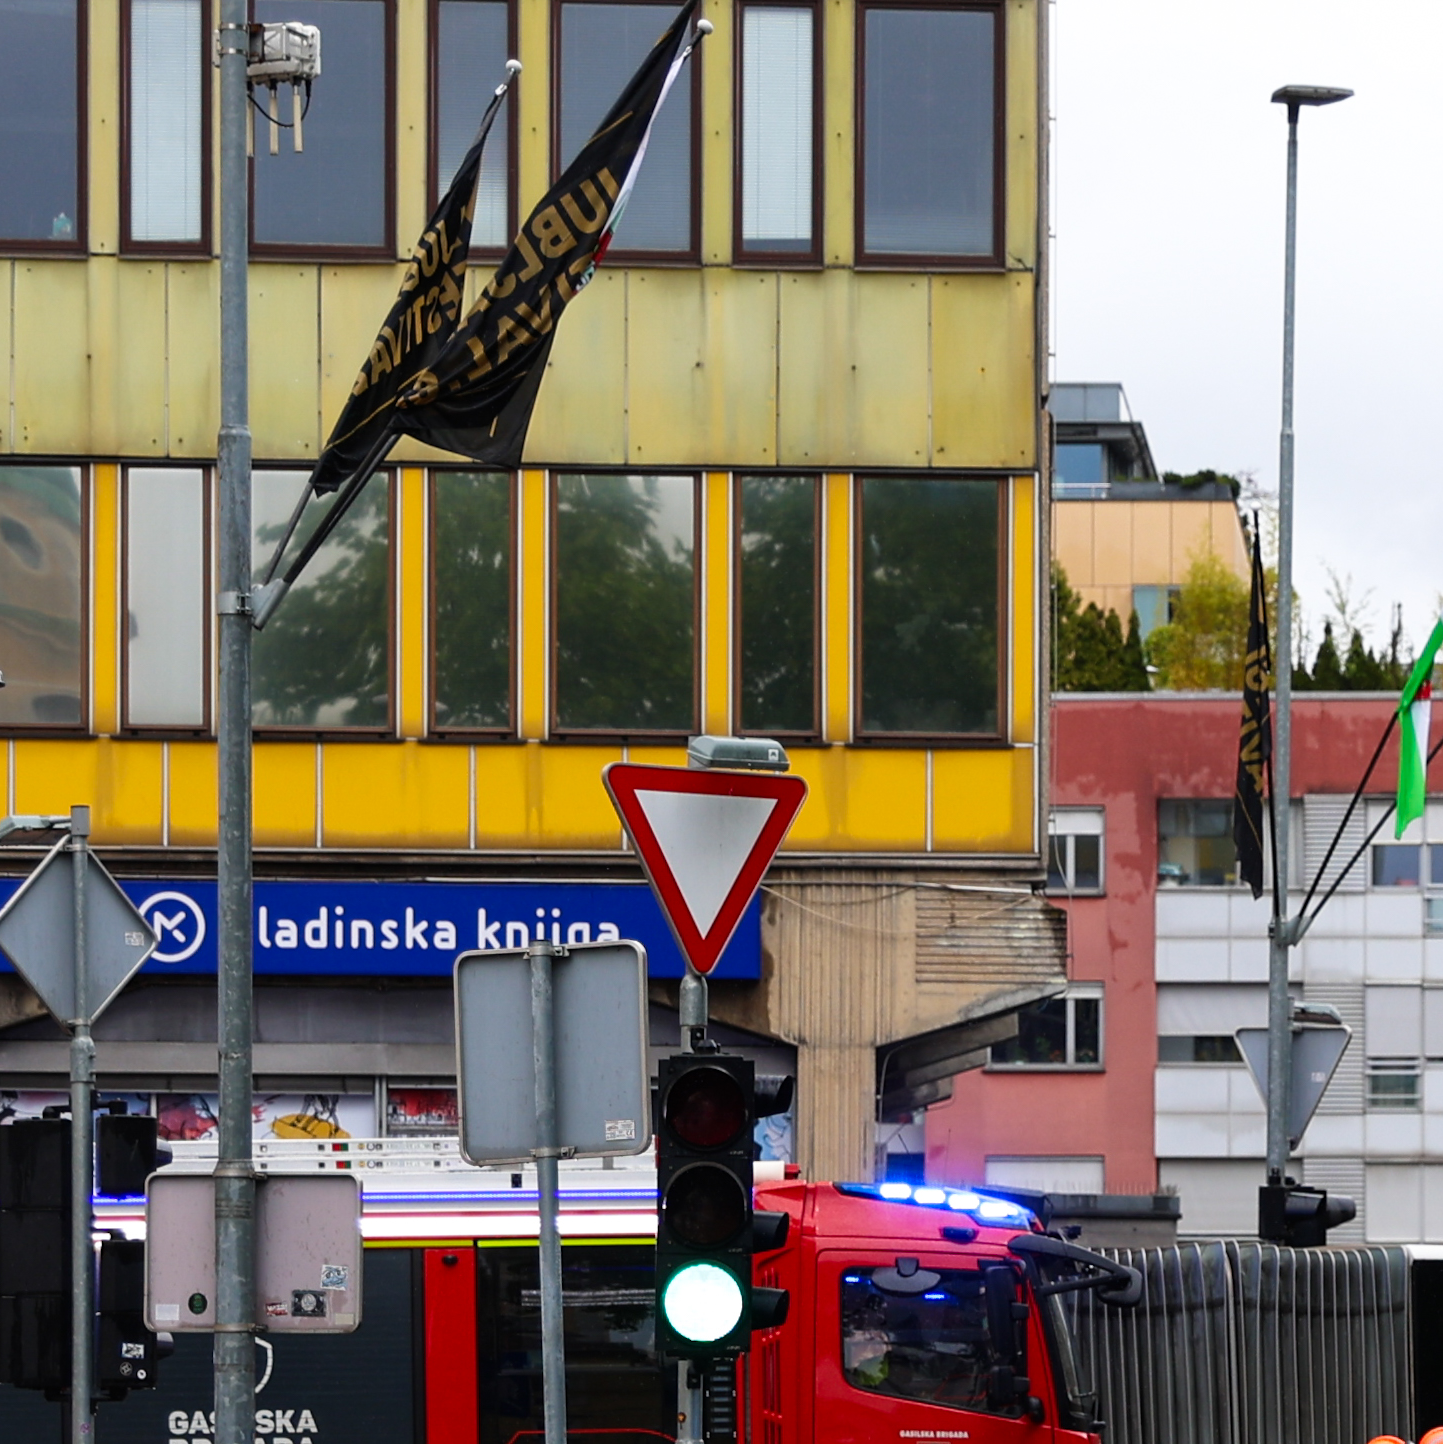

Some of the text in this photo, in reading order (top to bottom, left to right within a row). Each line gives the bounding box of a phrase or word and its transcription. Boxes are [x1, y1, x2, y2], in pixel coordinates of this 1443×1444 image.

[258, 905, 457, 951] ladinska
[167, 1409, 319, 1435] GASKA
[899, 1430, 969, 1439] GASILSKA BRIGADA
